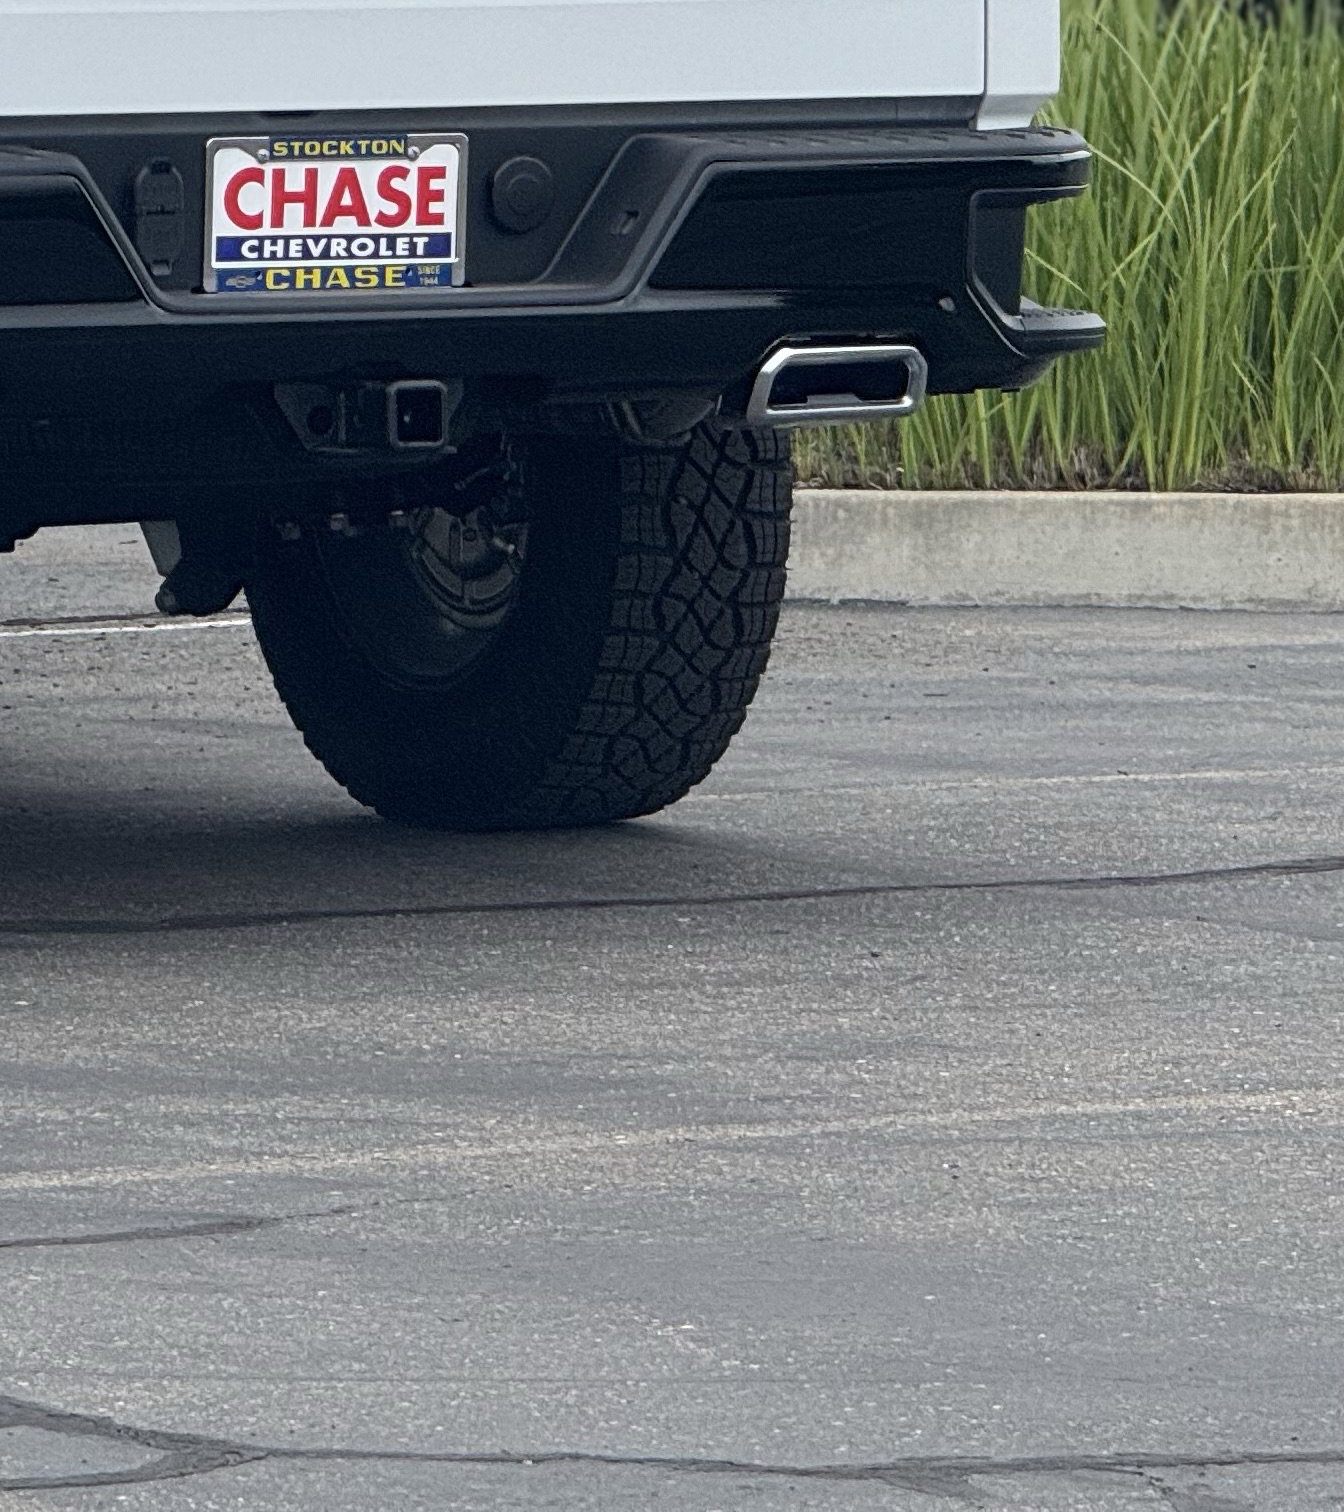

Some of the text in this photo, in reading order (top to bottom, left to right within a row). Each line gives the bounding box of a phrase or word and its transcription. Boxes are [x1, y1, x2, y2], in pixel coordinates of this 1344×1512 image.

[272, 138, 405, 157] STOCKTON
[224, 165, 447, 230] CHASE
[240, 236, 430, 260] CHEVROLET
[265, 265, 407, 290] CHASE
